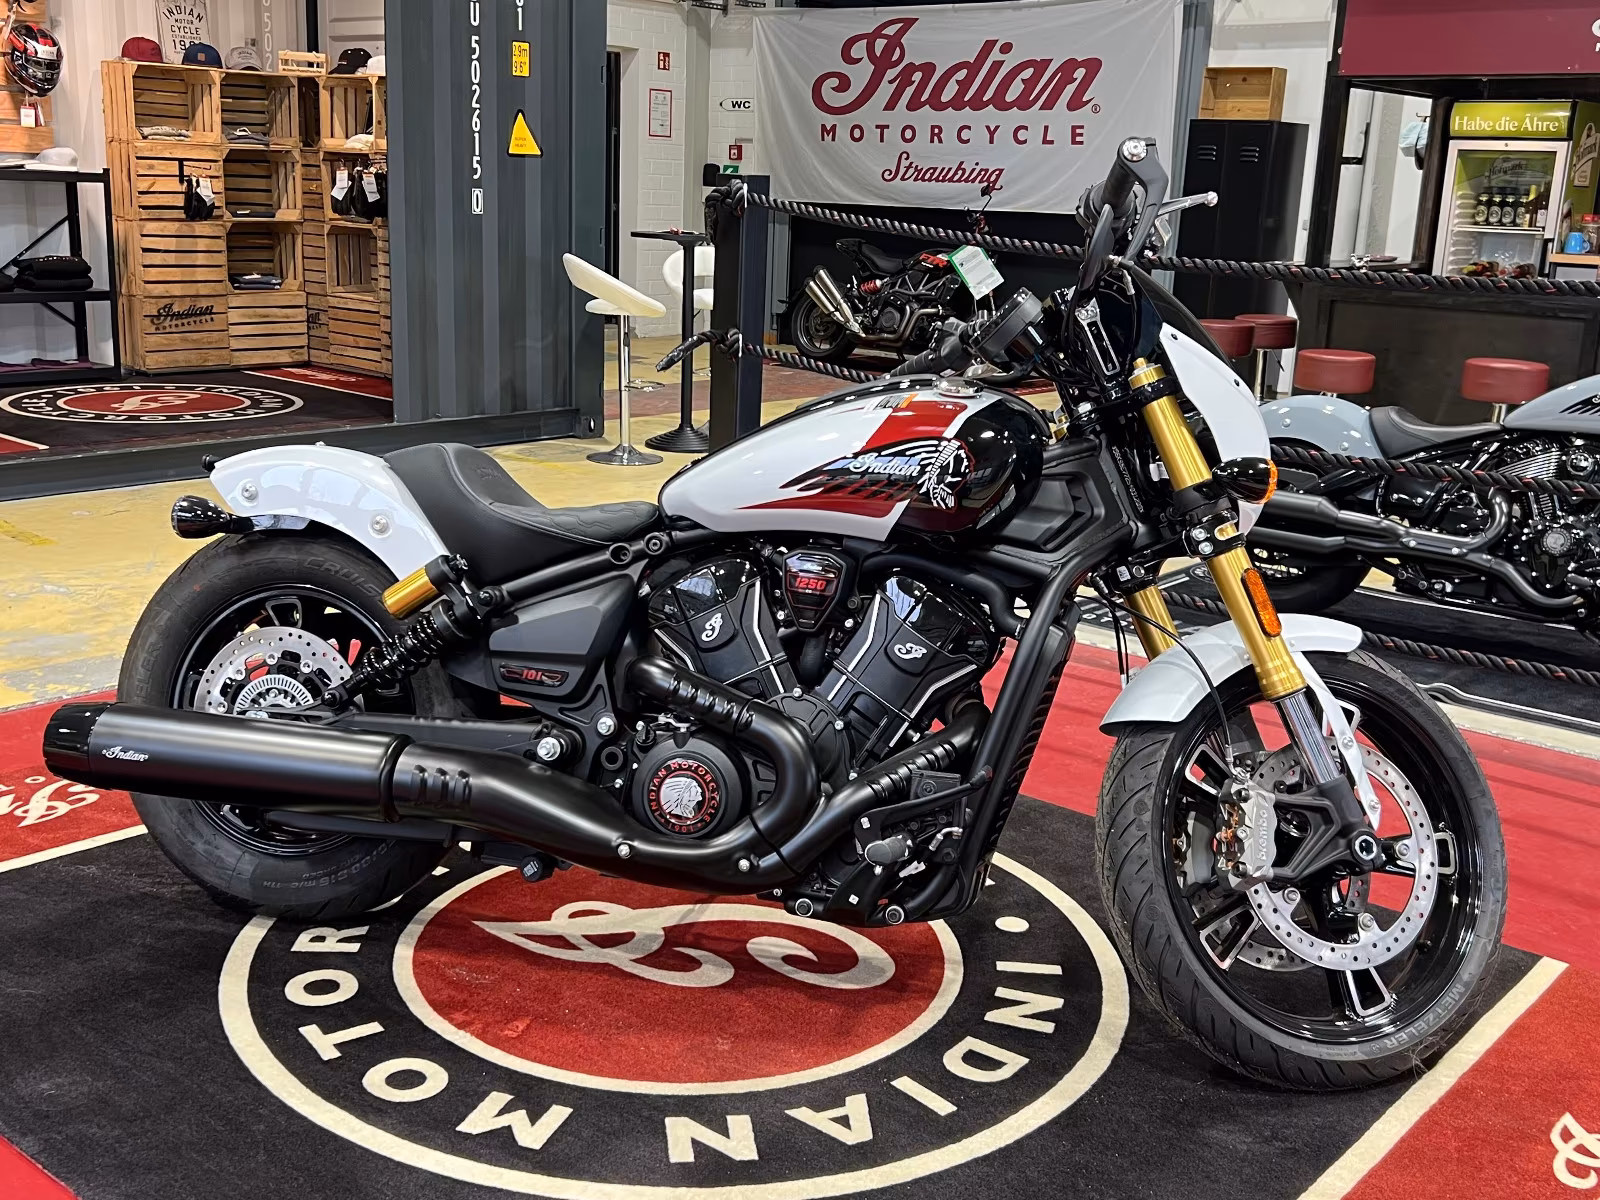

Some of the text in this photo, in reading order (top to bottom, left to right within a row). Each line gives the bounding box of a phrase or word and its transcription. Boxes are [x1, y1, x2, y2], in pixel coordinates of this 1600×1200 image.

[162, 4, 204, 23] INDIAN
[170, 24, 201, 36] CYCLE
[811, 16, 1102, 116] Indian
[731, 100, 751, 109] WC
[1454, 115, 1494, 131] Habe
[1495, 115, 1519, 132] die
[820, 123, 1086, 146] MOTORCYCLE
[881, 150, 1006, 191] Straubing
[150, 302, 214, 326] Indian
[155, 316, 215, 331] MOTORCYCLE
[848, 452, 921, 477] Indian
[795, 577, 827, 590] 1250
[522, 669, 543, 681] 101
[105, 745, 146, 762] Indian
[1384, 983, 1465, 1050] METZELER
[664, 960, 1065, 1164] INDIAN
